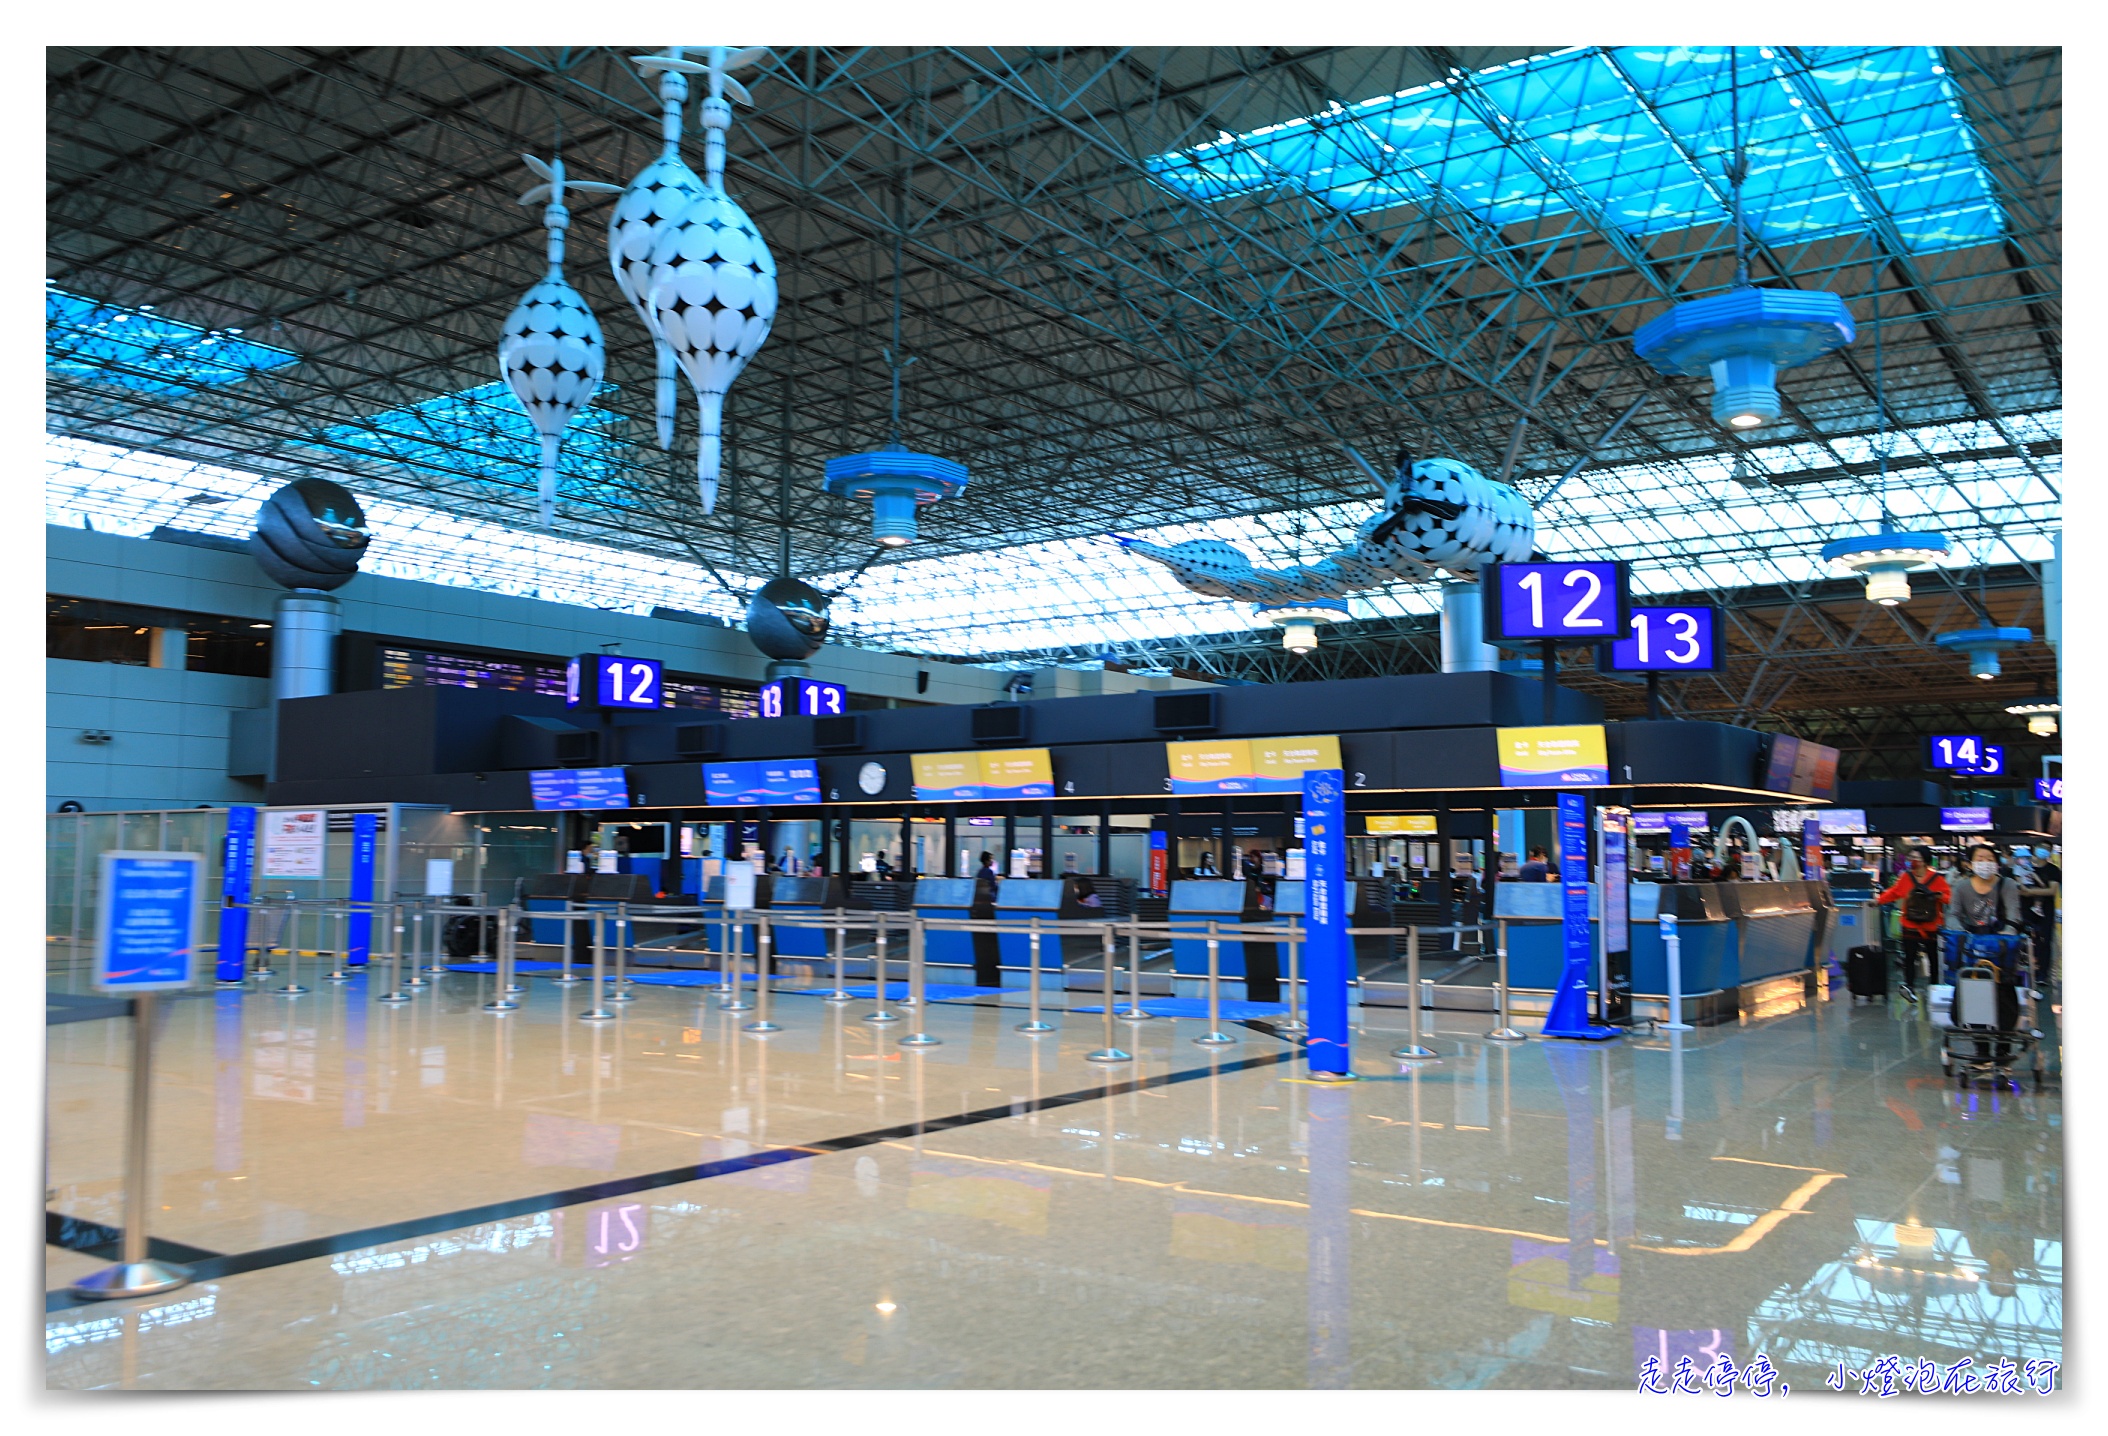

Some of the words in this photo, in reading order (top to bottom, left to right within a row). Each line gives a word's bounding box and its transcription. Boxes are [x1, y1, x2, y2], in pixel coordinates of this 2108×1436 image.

[1517, 569, 1603, 628] 12
[1630, 612, 1700, 664] 13
[606, 662, 654, 704] 12
[762, 685, 782, 717] 13
[805, 685, 841, 716] 13
[1938, 738, 1979, 765] 14
[1163, 777, 1174, 791] 3
[1354, 772, 1367, 787] 2
[1622, 764, 1633, 781] 1
